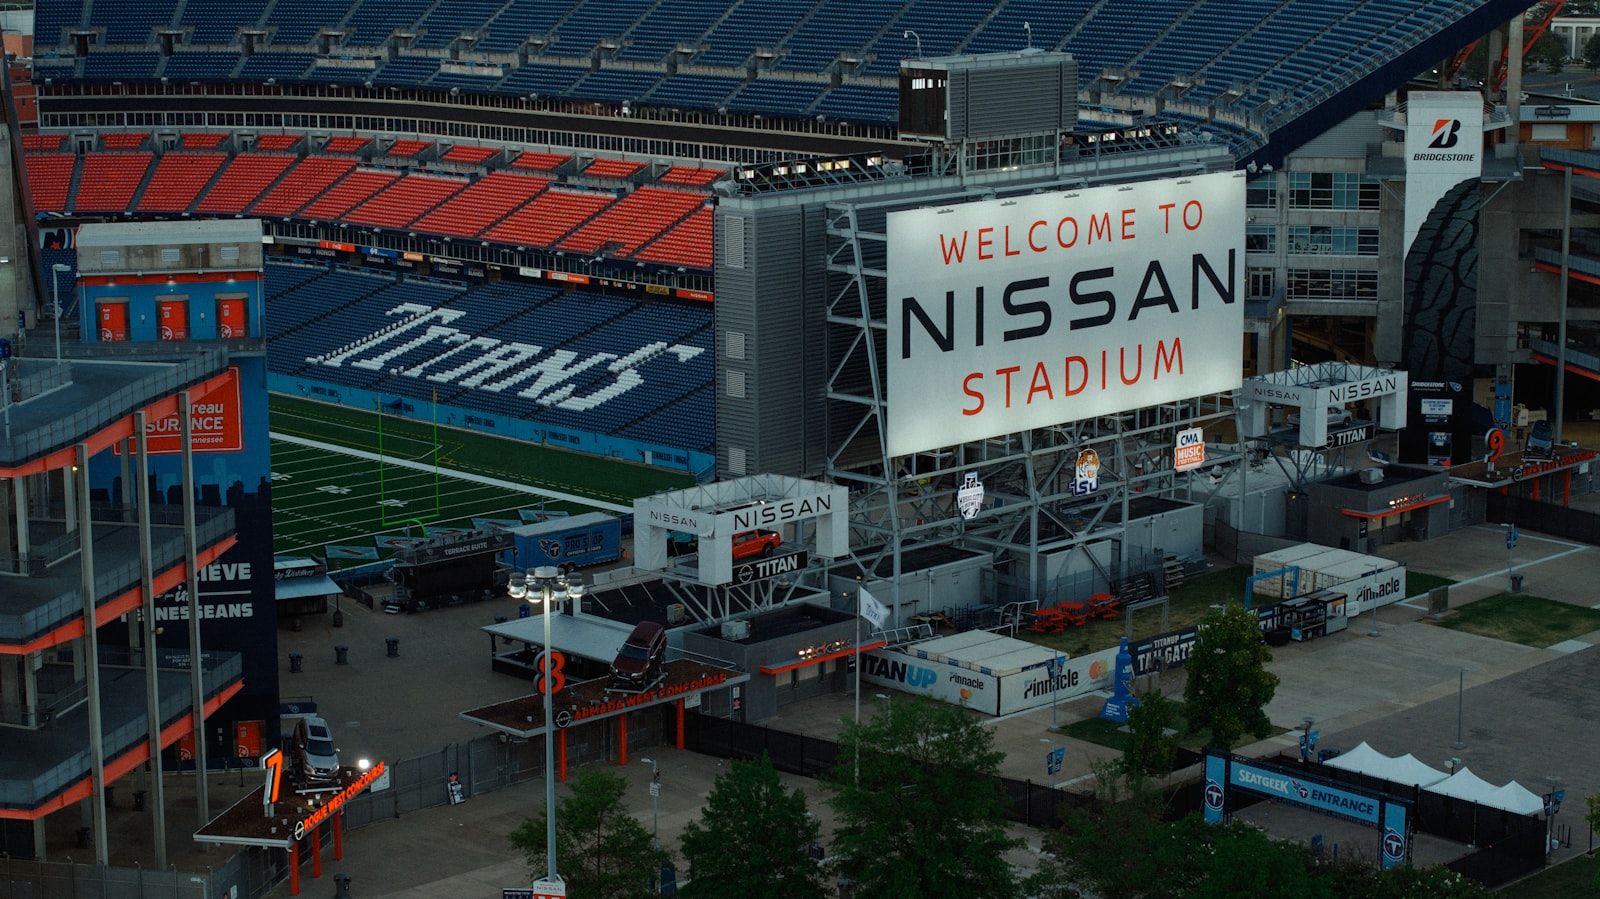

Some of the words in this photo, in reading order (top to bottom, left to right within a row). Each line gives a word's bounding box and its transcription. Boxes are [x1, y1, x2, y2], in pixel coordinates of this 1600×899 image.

[1413, 153, 1475, 162] BRIDGESTONE
[939, 208, 1136, 265] WELCOME
[1158, 199, 1203, 235] TO
[901, 248, 1236, 359] NISSAN
[305, 302, 705, 412] TITANS
[961, 336, 1184, 416] STADIUM
[1328, 377, 1397, 403] NISSAN
[1254, 387, 1300, 401] NISSAN
[1178, 445, 1202, 459] MUSIC
[1181, 433, 1199, 446] CMA
[1336, 427, 1367, 446] TITAN
[1486, 428, 1506, 462] 9
[650, 510, 697, 528] NISSAN
[734, 494, 831, 530] NISSAN
[756, 554, 799, 578] TITAN
[1153, 634, 1180, 649] TITANUP
[535, 650, 567, 696] 8
[949, 671, 985, 690] Pinnacle
[572, 699, 625, 721] ARMADA
[624, 690, 658, 708] WEST
[657, 673, 727, 699] CONCOURSE
[262, 748, 284, 804] 1
[1238, 768, 1290, 794] SEATGEEK
[1311, 789, 1375, 815] ENTRANCE
[303, 804, 328, 832] ROGUE
[327, 790, 346, 813] WEST
[345, 760, 385, 799] CONCOURSE
